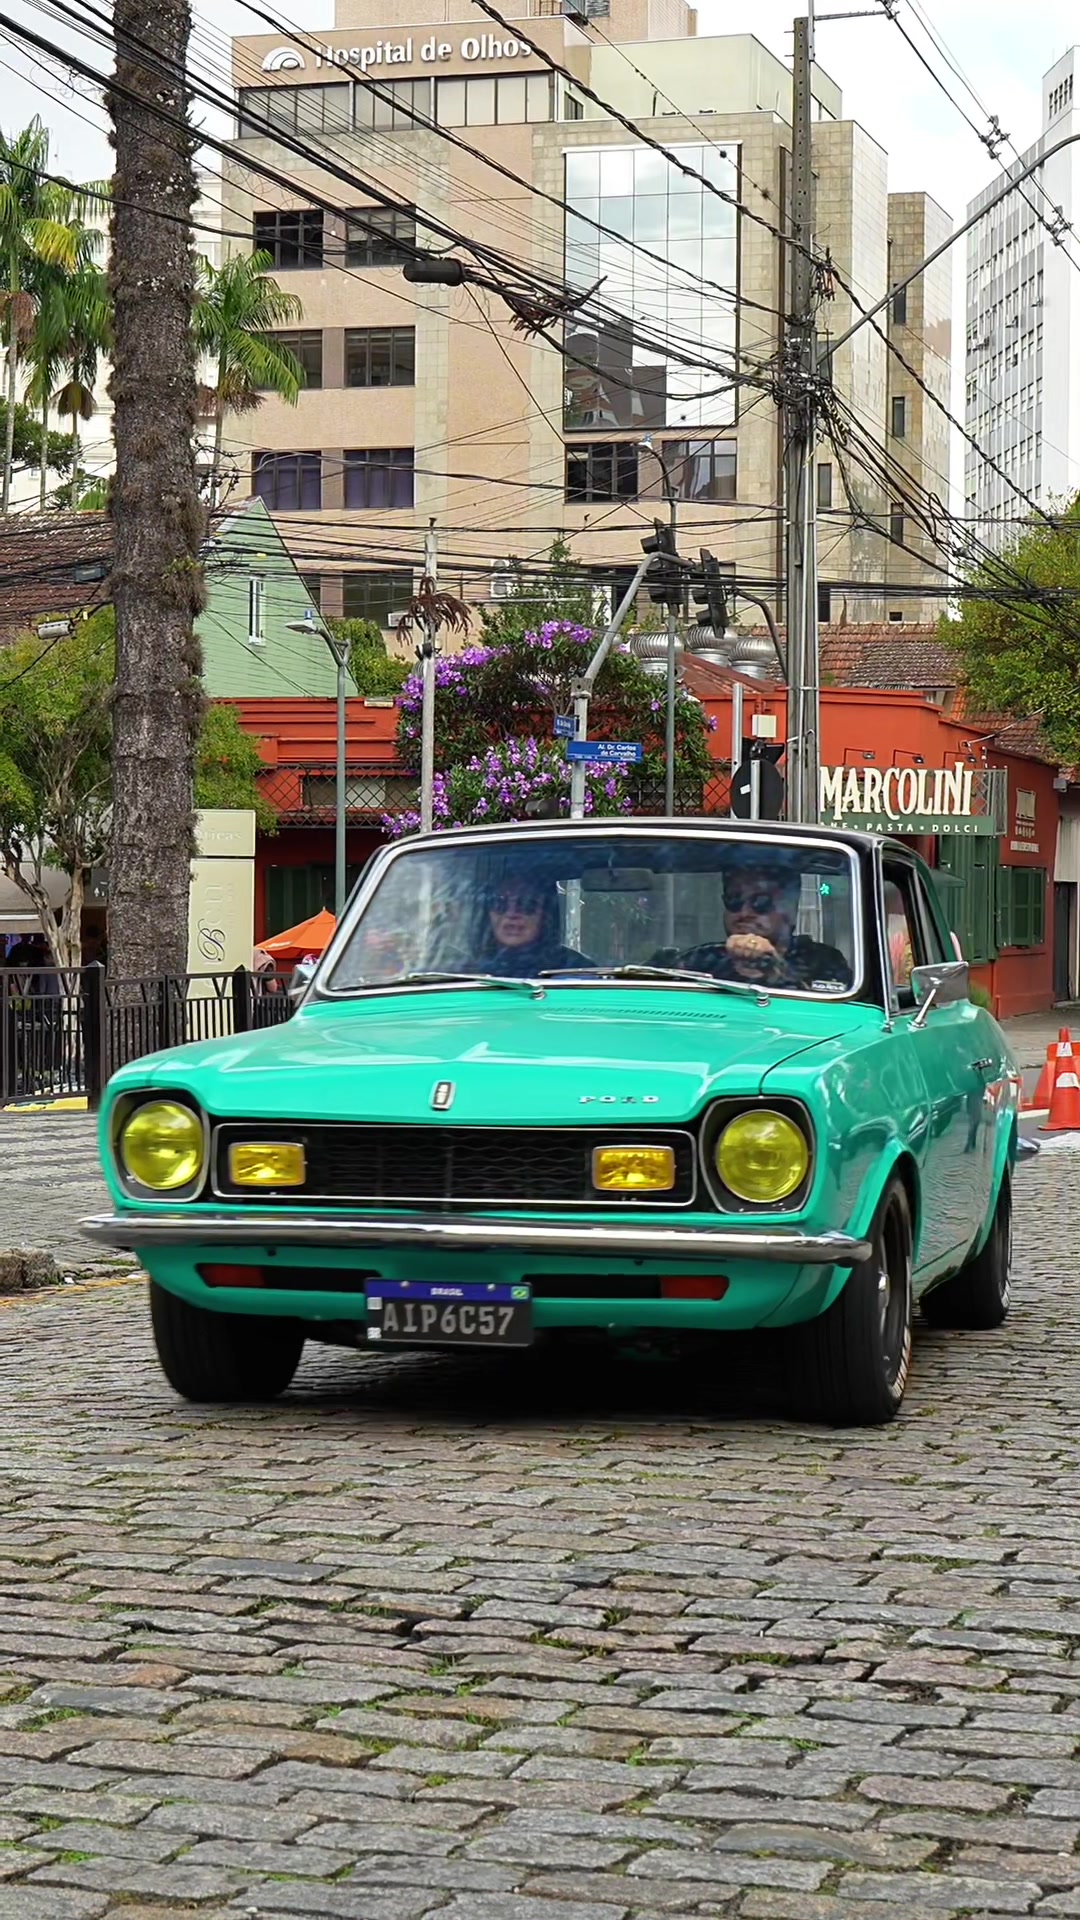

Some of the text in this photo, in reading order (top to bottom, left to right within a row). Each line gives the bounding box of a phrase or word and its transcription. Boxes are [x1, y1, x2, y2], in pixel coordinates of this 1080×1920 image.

[315, 34, 532, 72] Hospital de Olhos
[820, 762, 973, 820] MARCOLINI
[866, 823, 914, 832] PASTA
[932, 824, 978, 833] DOLCI
[383, 1302, 515, 1336] AIP6C57
